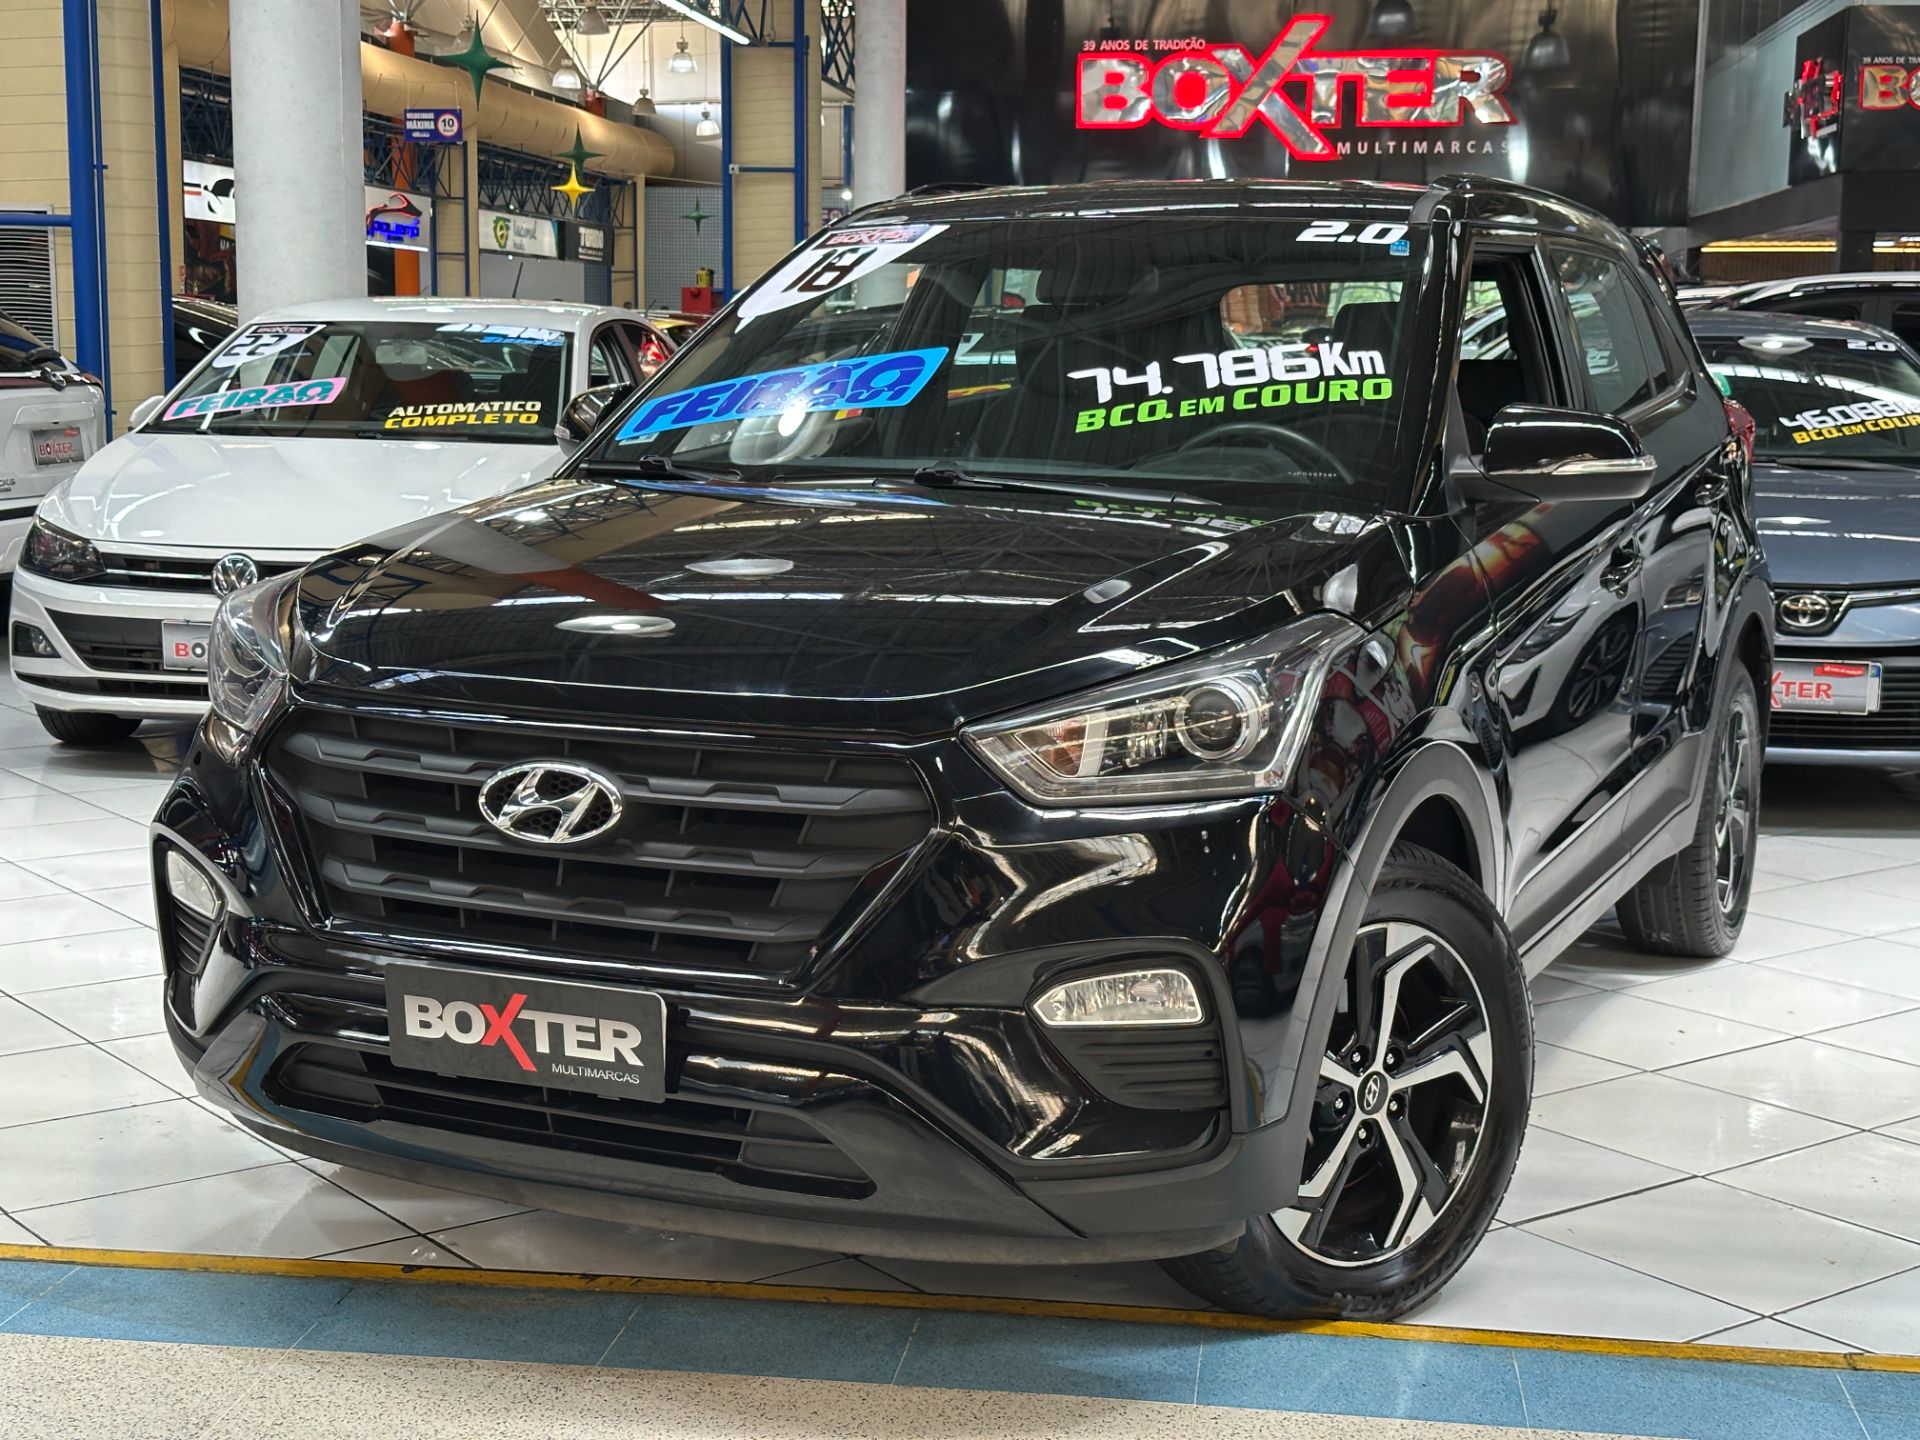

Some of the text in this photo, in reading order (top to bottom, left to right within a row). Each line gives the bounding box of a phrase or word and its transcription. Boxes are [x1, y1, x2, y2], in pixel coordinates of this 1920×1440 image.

[1082, 36, 1206, 52] 39 ANOS DE TRADIÇÃO
[1873, 56, 1894, 64] ANOS
[1895, 56, 1906, 64] DE
[1076, 13, 1518, 161] BOXTER
[441, 118, 455, 128] 10
[1336, 140, 1510, 155] MULTIMARCAS
[1295, 220, 1409, 245] 2.0
[1846, 339, 1897, 352] 2.0
[171, 381, 335, 417] FEIRÃO
[632, 354, 926, 433] FEIRÃO
[1179, 396, 1225, 418] EM
[1232, 378, 1393, 410] COURO
[384, 412, 539, 430] COMPLETO
[1841, 423, 1867, 436] EM
[174, 641, 209, 661] BO
[403, 992, 645, 1072] BOXTER
[551, 1062, 641, 1084] MULTIMARCAS
